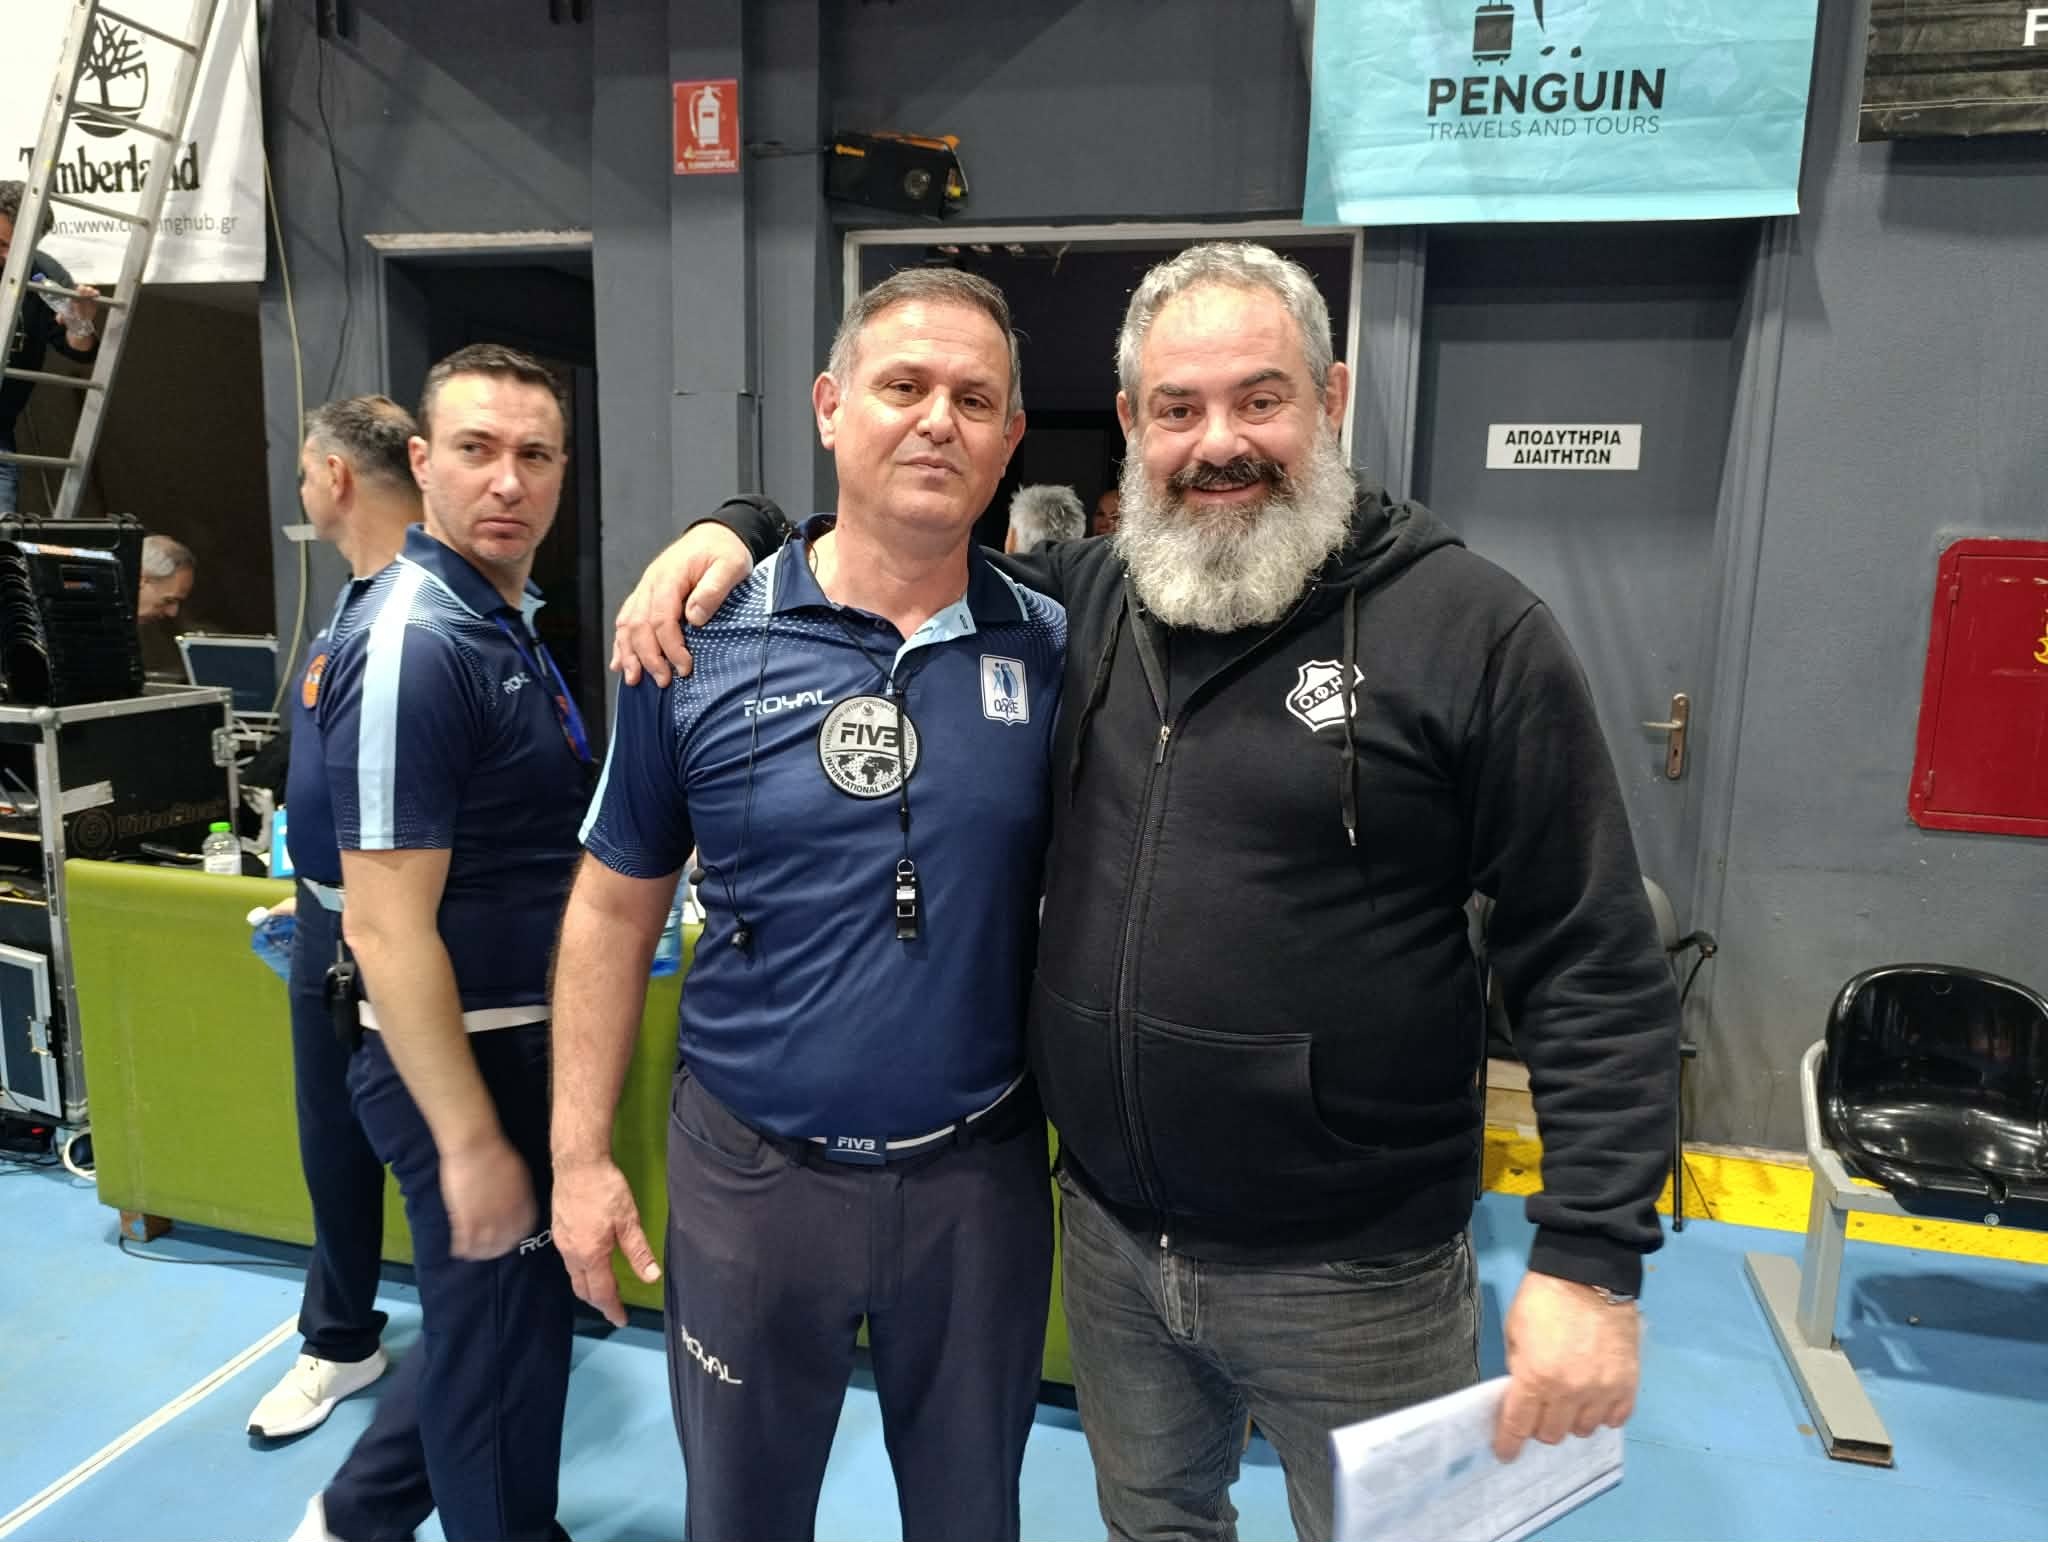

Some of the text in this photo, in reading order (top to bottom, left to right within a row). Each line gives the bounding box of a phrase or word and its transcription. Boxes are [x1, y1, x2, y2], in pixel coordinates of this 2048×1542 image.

[1427, 68, 1666, 117] PENGUIN
[1427, 115, 1660, 141] TRAVELS AND TOURS
[1505, 430, 1622, 445] ΑΠΟΔΥΤΗΡΙΑ
[1513, 449, 1611, 464] ΔΙΑΙΤΗΤΩΝ
[743, 689, 834, 717] ROYAL
[824, 755, 881, 794] INTERNATIONAL
